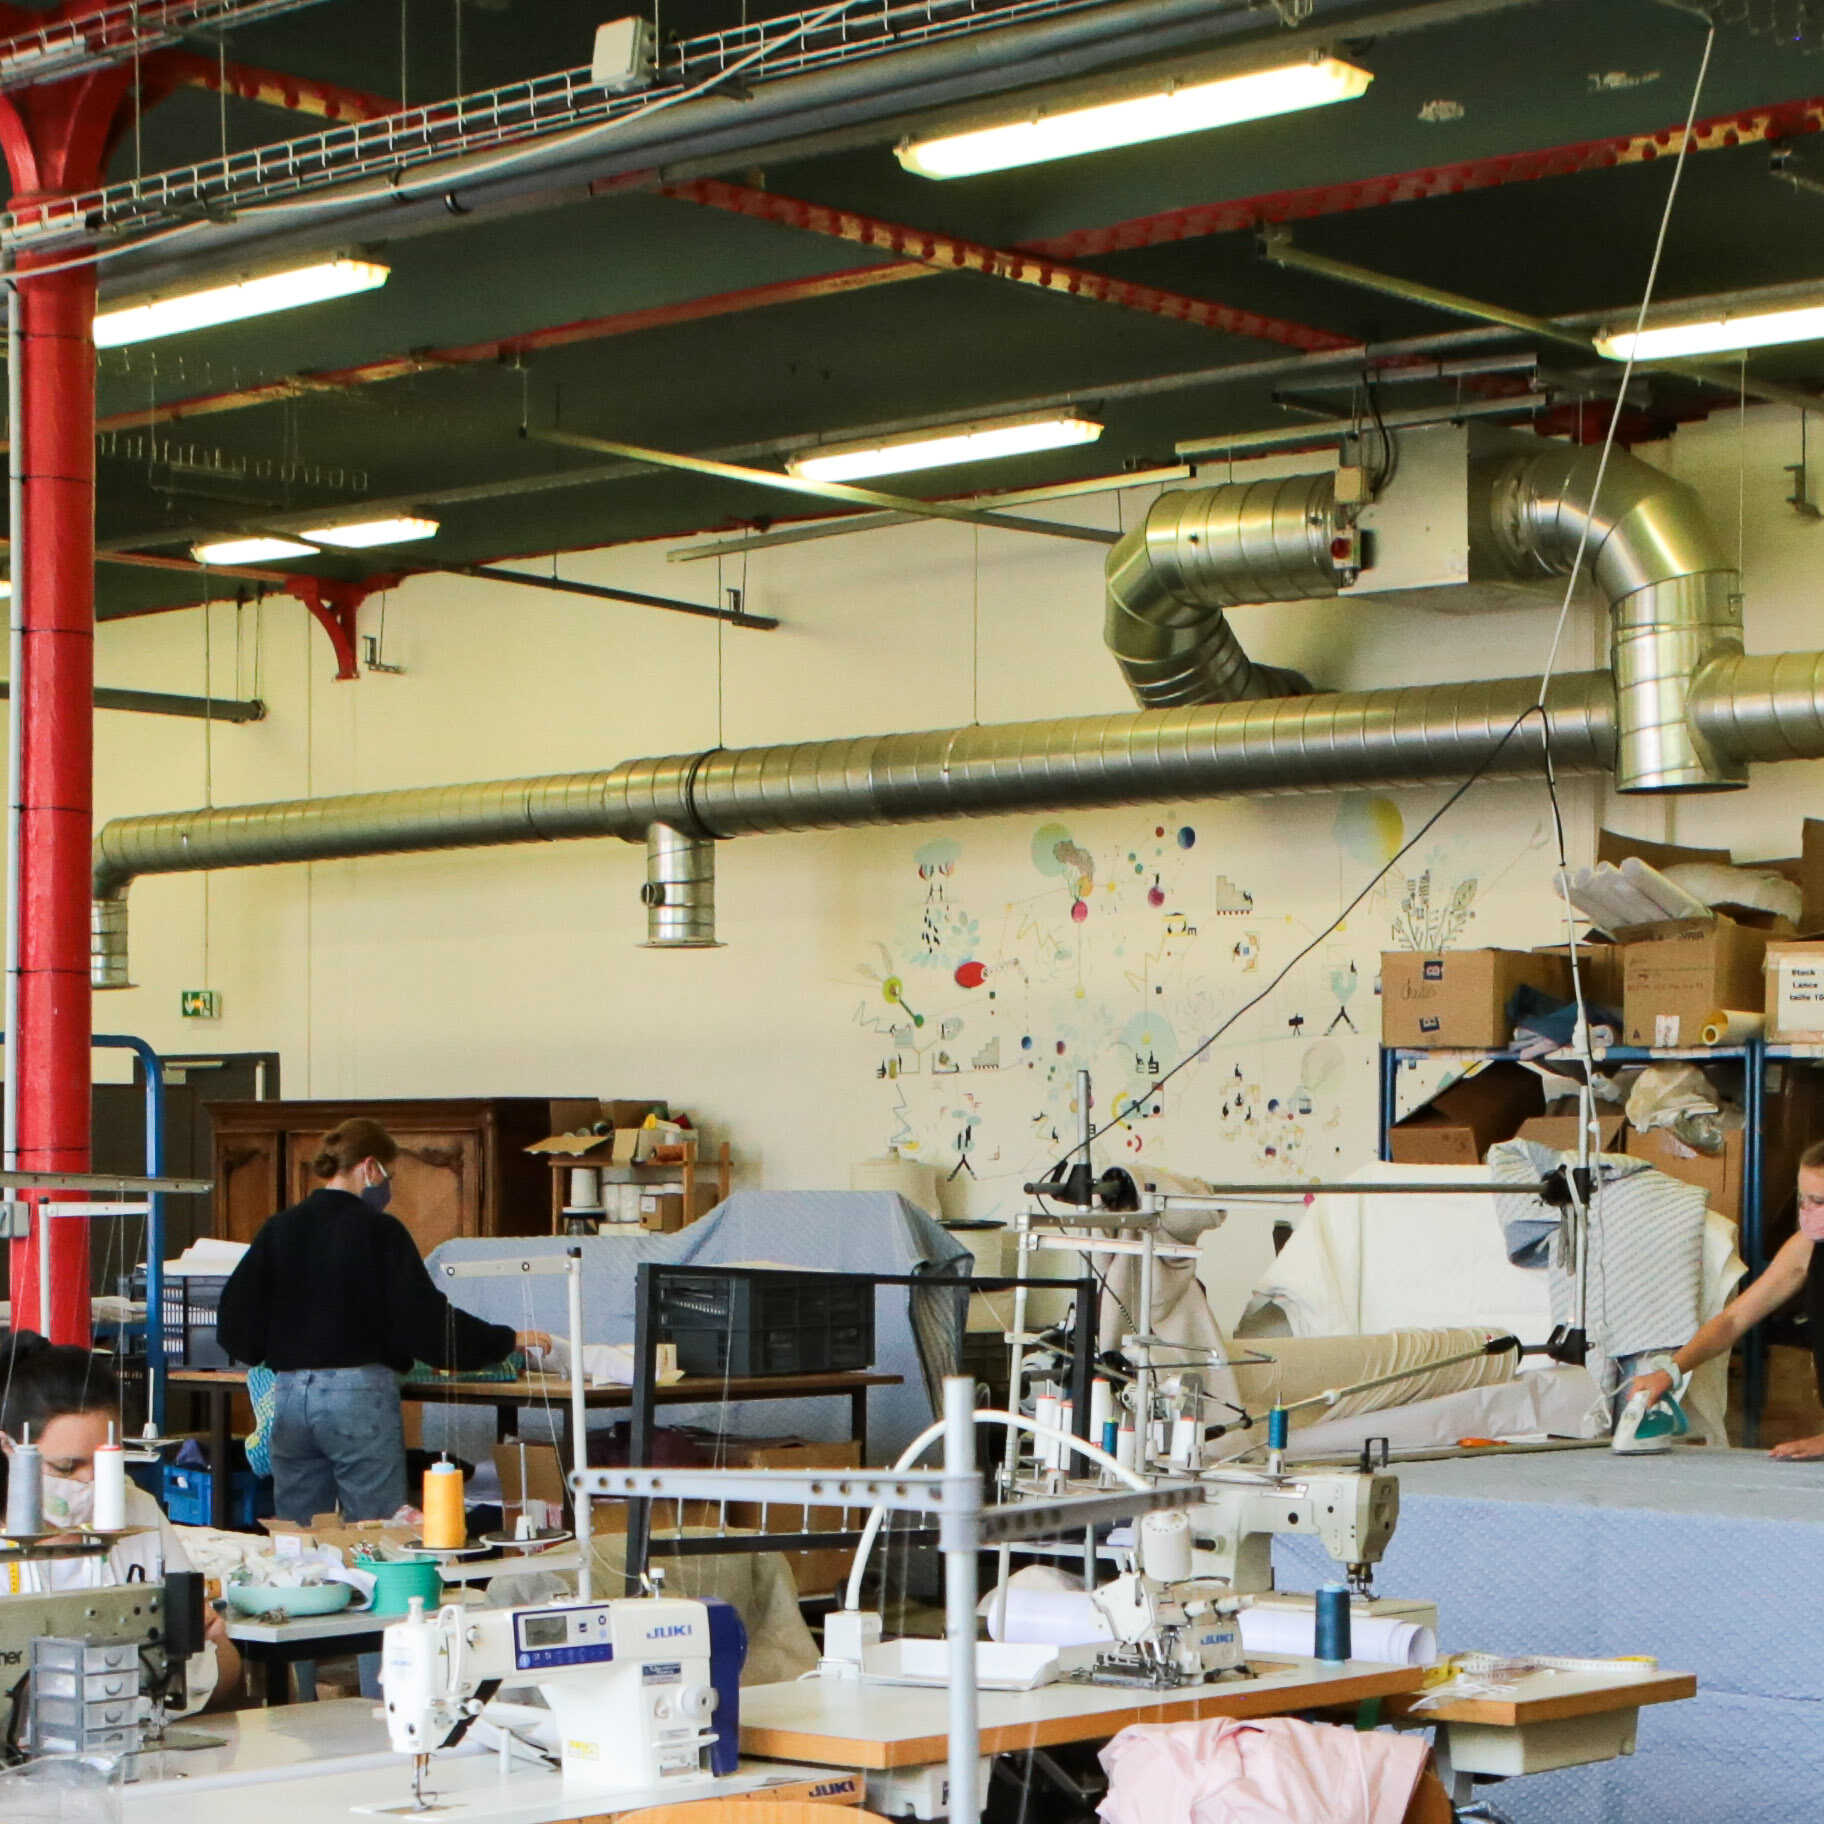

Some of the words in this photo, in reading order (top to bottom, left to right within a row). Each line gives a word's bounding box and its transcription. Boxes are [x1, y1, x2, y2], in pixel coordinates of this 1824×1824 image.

[646, 1624, 693, 1639] JUKI
[1200, 1633, 1234, 1645] JUKI
[809, 1780, 856, 1797] JUKI
